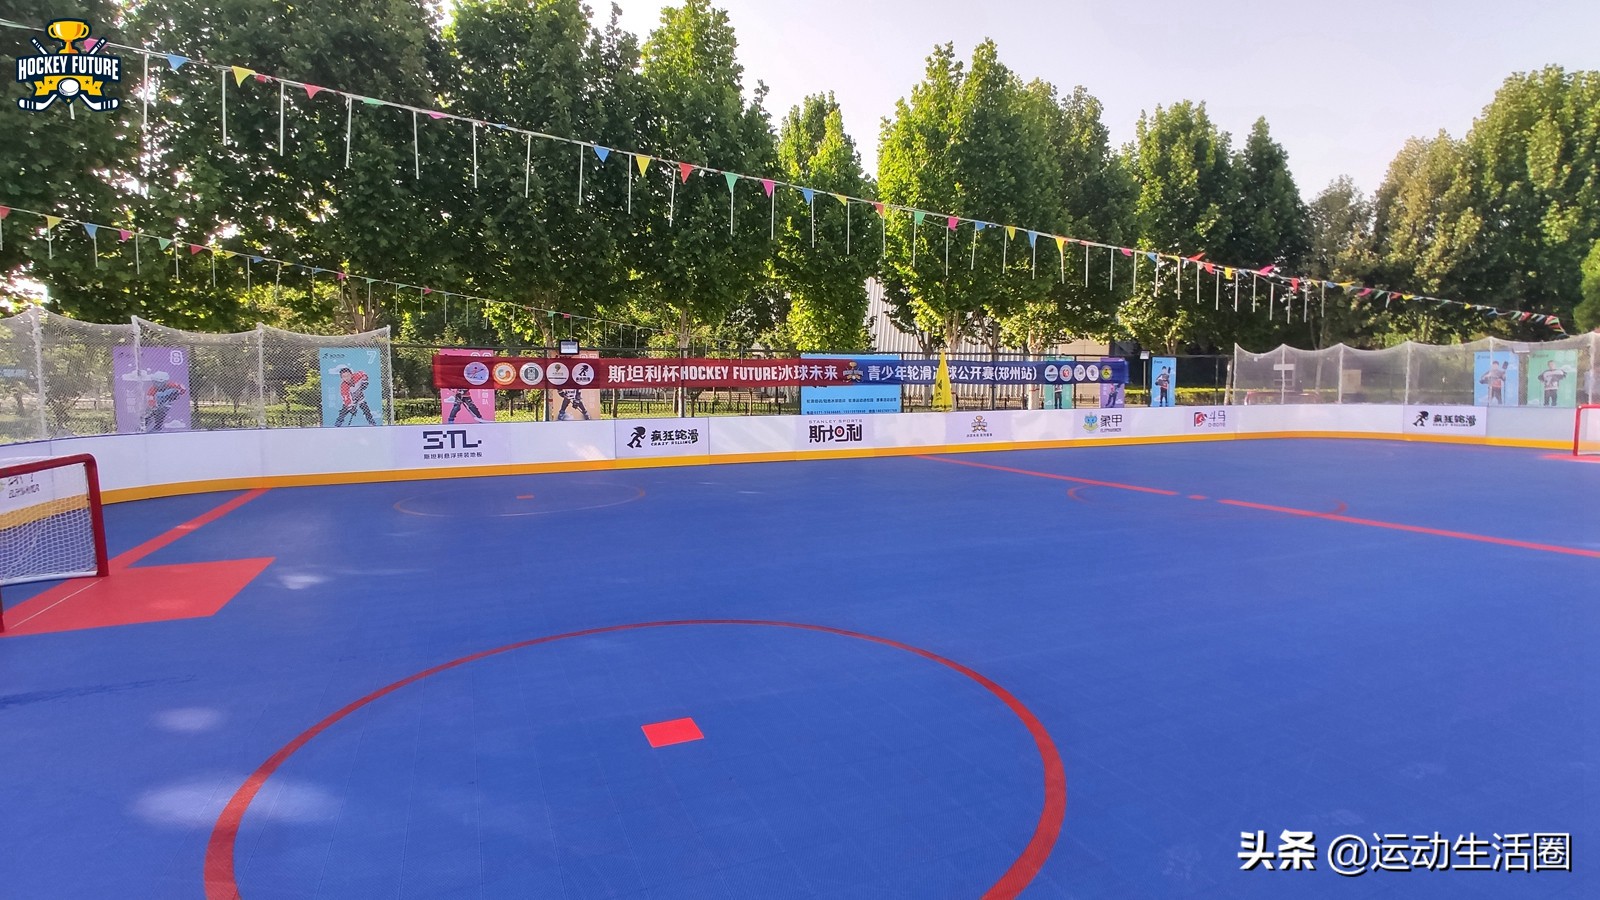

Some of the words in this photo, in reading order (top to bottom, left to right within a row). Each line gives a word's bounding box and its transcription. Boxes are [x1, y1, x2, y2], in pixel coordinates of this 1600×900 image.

[367, 351, 377, 364] 7
[1100, 414, 1123, 428] 象甲
[1433, 413, 1477, 427] 疯狂轮滑
[651, 428, 699, 444] 疯狂轮滑
[809, 424, 862, 443] 斯坦利
